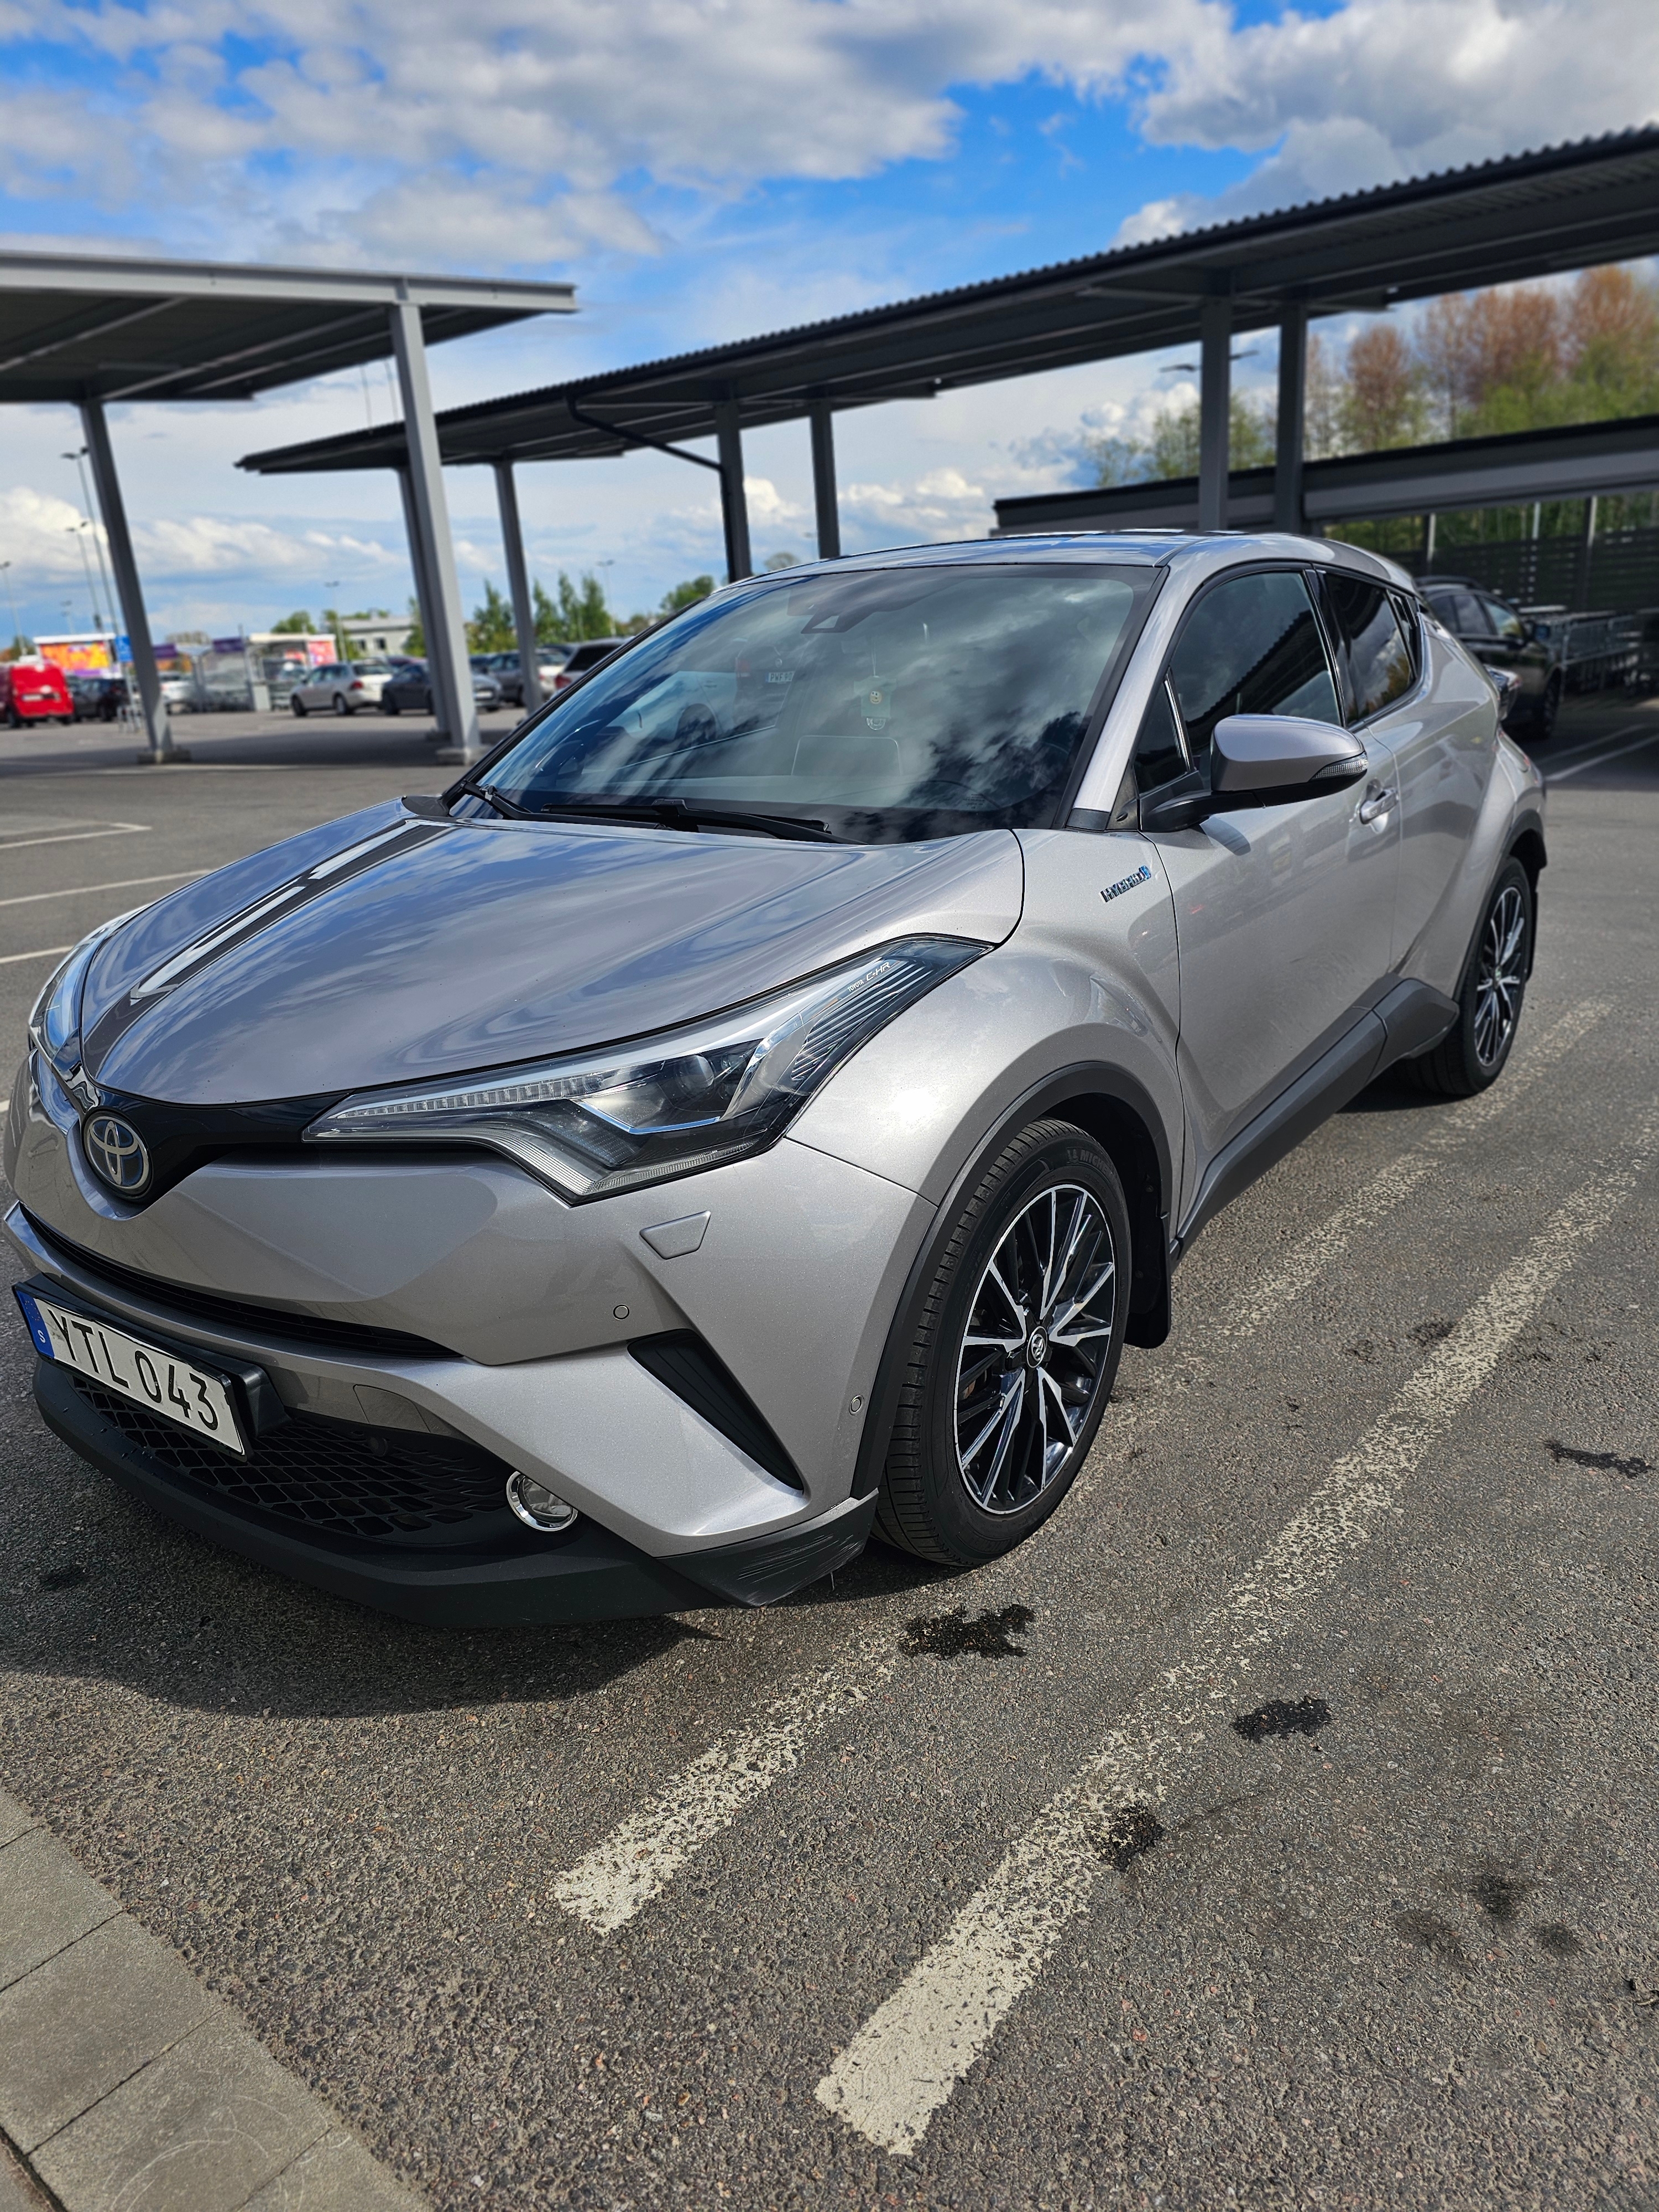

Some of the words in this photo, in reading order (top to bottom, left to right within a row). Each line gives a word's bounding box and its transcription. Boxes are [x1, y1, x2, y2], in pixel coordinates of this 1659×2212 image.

[770, 673, 784, 682] PWF
[1100, 871, 1146, 902] HYBRID
[847, 979, 864, 992] TOYOTA
[866, 962, 890, 981] C-HR
[1079, 1149, 1110, 1177] MICHE
[38, 1330, 46, 1343] S
[47, 1308, 129, 1389] YTL
[134, 1350, 218, 1431] 043
